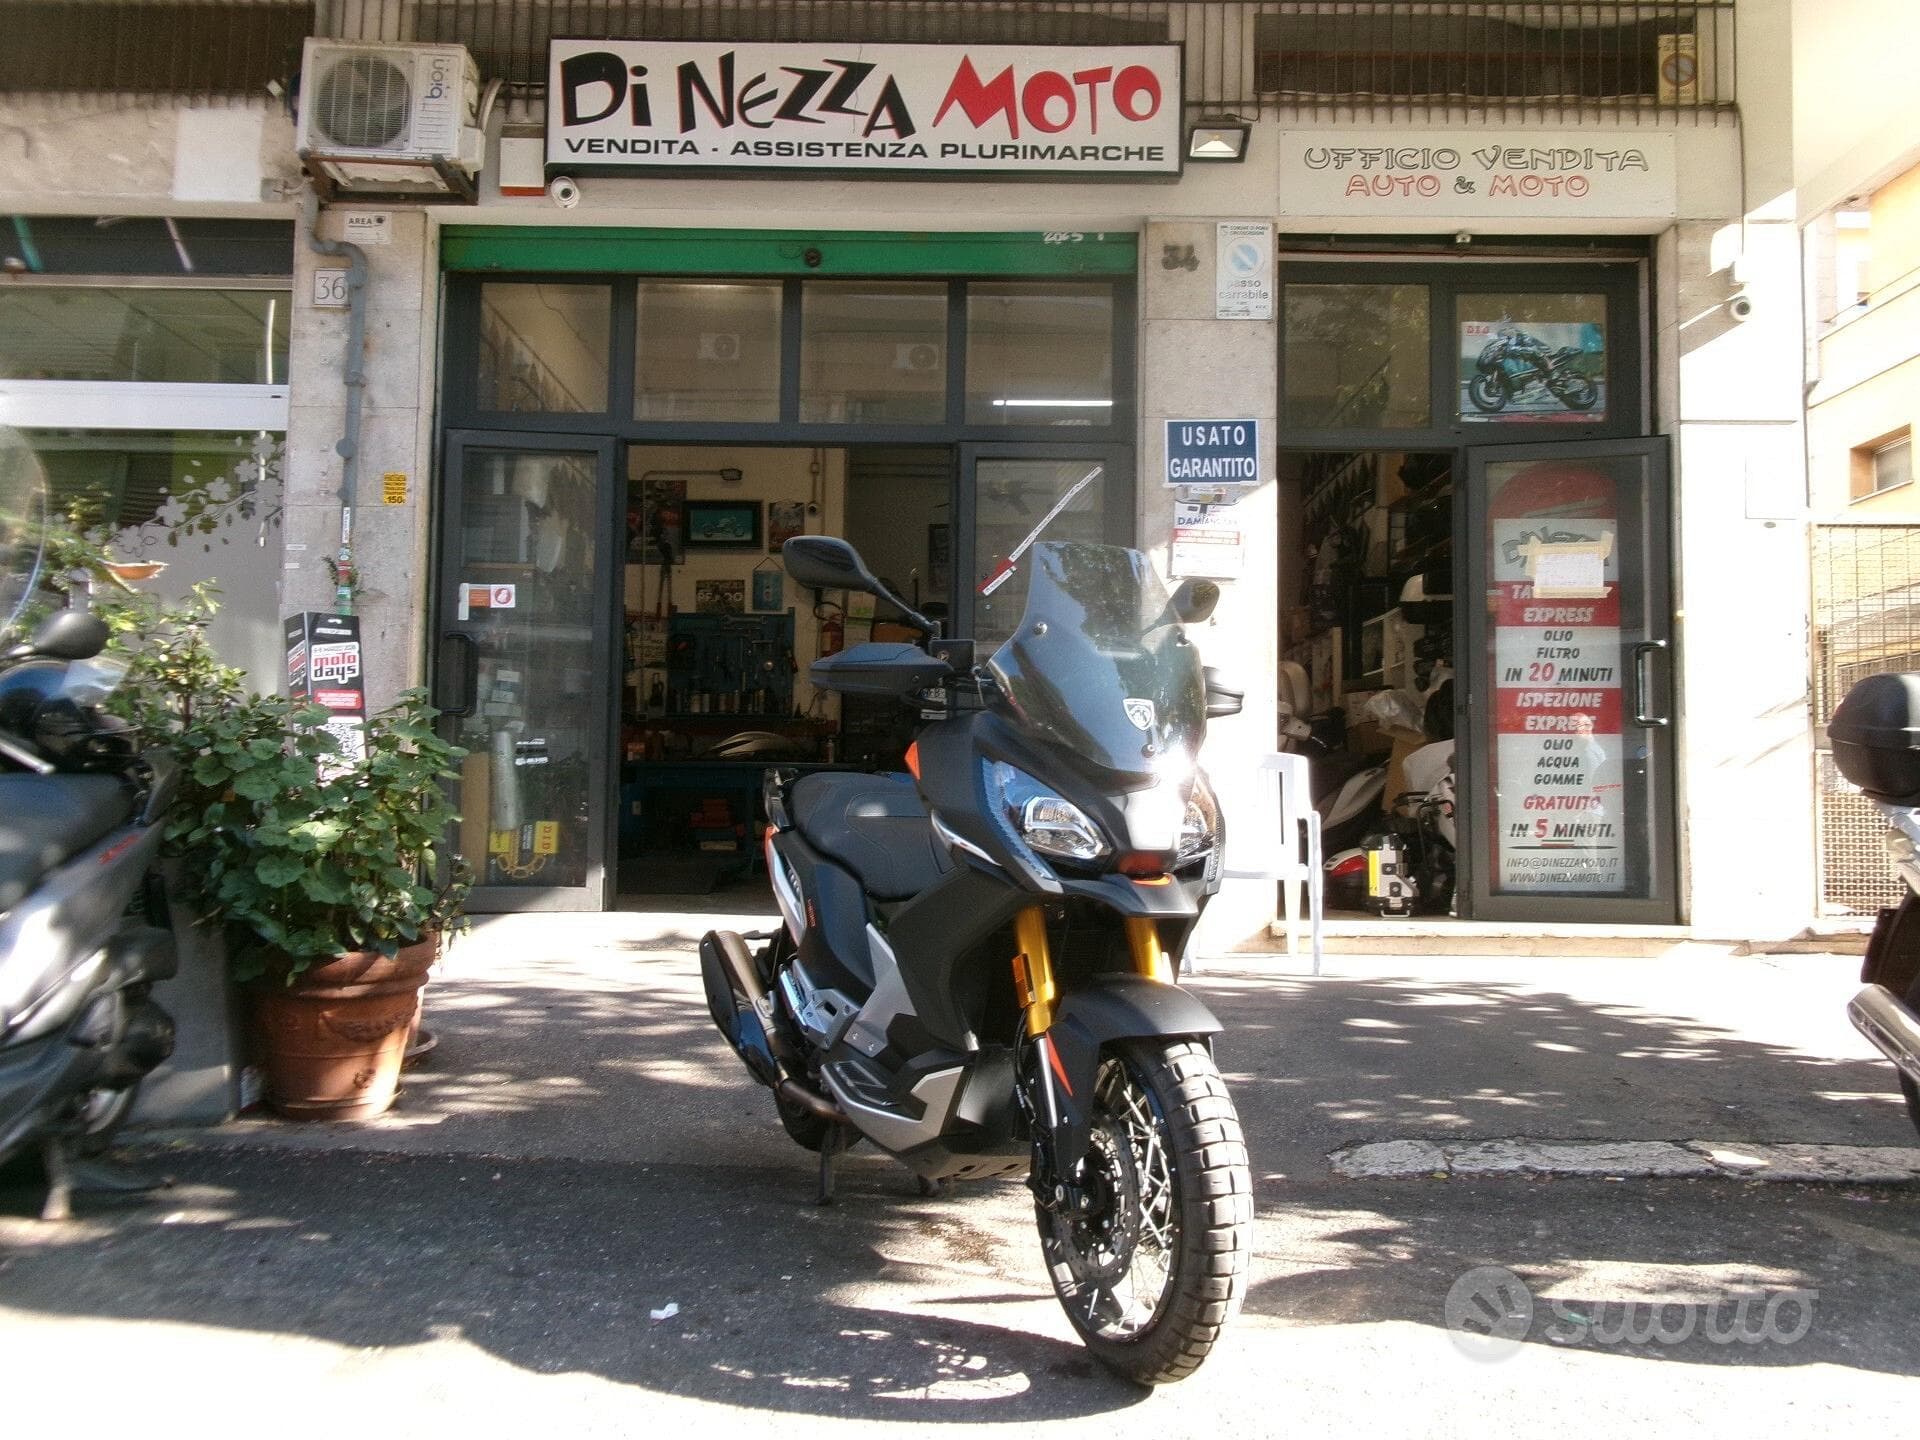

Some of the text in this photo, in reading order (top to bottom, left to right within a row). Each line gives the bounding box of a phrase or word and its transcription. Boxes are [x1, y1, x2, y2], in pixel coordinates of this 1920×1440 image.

[931, 53, 1162, 141] MOTO
[564, 137, 700, 156] VENDITA
[729, 140, 929, 160] ASSISTENZA
[939, 142, 1165, 162] PLURIMARCHE
[1303, 144, 1649, 172] UFFICIO VENDITA
[1344, 173, 1590, 198] AUTO & MOTO
[347, 217, 373, 226] AREA
[316, 276, 346, 300] 36
[1181, 425, 1246, 446] USATO
[1169, 457, 1256, 478] GARANTITO
[1523, 607, 1595, 623] EXPRESS
[1543, 630, 1574, 642] OLIO
[314, 652, 357, 667] moto
[1536, 647, 1580, 659] FILTRO
[314, 664, 357, 681] days
[1505, 662, 1613, 683] IN 20 MINUTI
[1516, 691, 1604, 708] ISPEZIONE
[1543, 739, 1574, 751] OLIO
[1536, 757, 1580, 768] ACQUA
[1533, 773, 1585, 786] GOMME
[1523, 795, 1602, 811] GRATUITO
[1510, 823, 1529, 838] IN
[1534, 818, 1549, 839] 5
